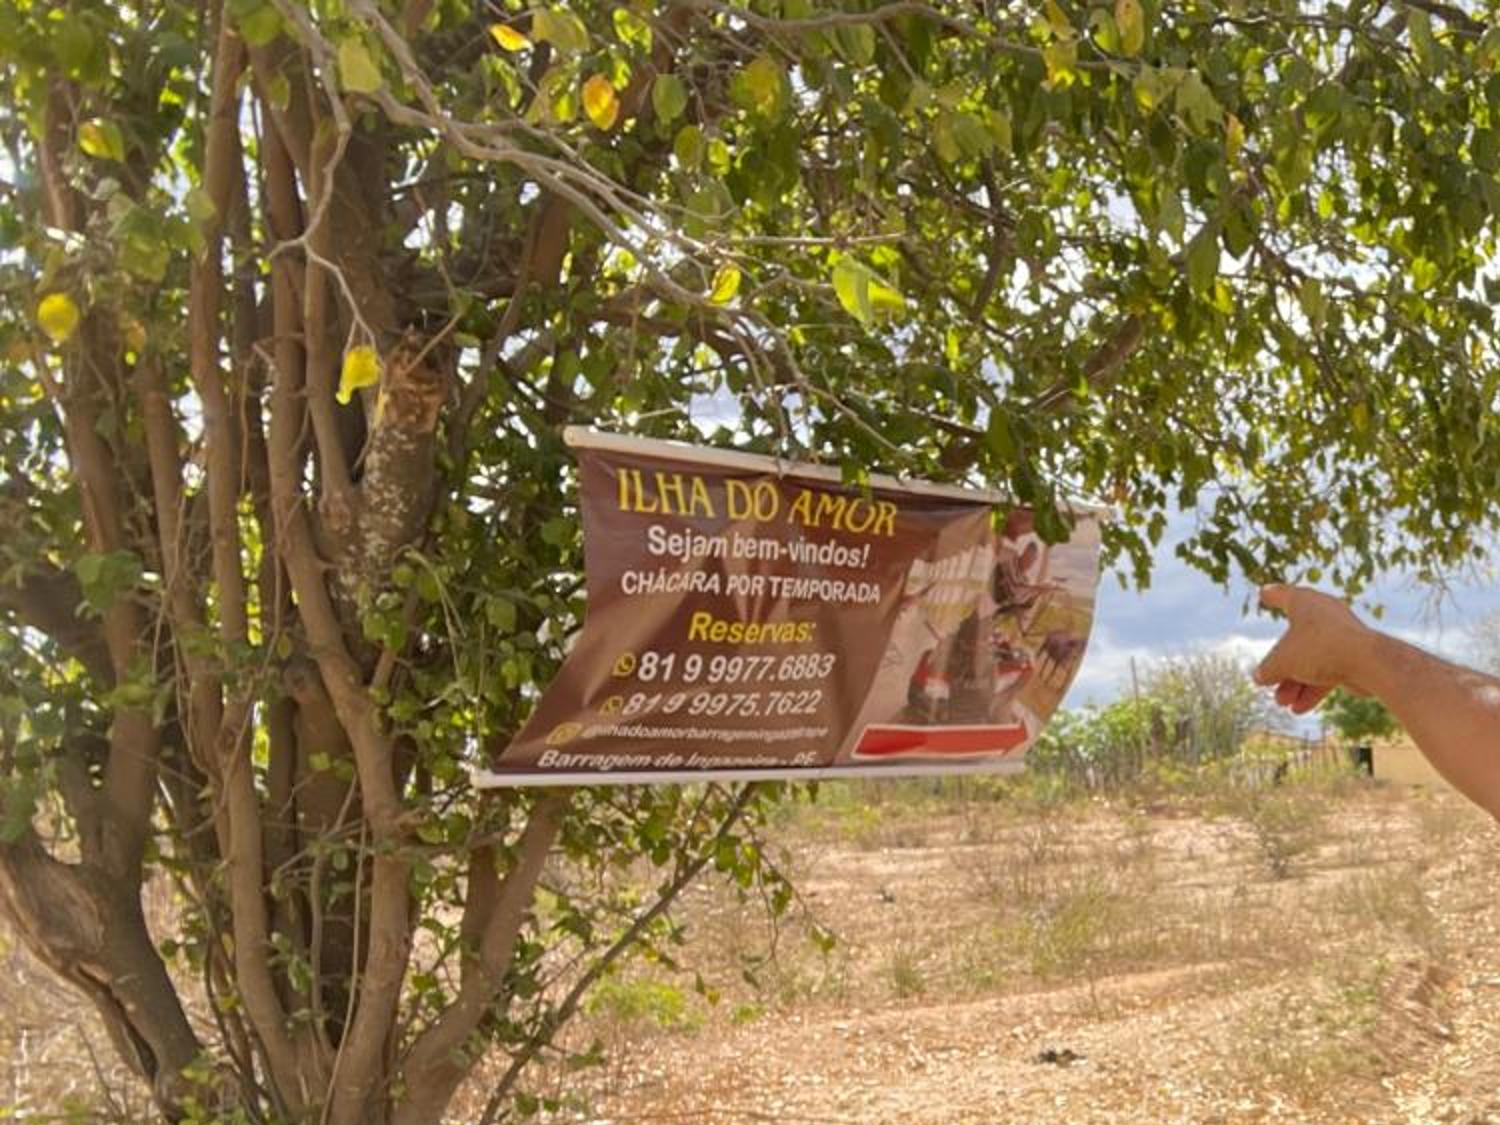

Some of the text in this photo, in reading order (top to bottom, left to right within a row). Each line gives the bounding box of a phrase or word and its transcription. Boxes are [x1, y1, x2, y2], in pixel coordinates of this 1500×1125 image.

[617, 468, 898, 537] ILHA DO AMOR
[647, 524, 871, 568] Sejam bem-vindos!
[621, 567, 882, 604] CHÁCARA POR TEMPORADA
[687, 611, 818, 645] Reservas:
[637, 651, 837, 683] 81 9 9977.6883
[621, 689, 825, 718] 81 9 9975.7622
[536, 749, 652, 771] Barragem
[652, 752, 683, 768] de
